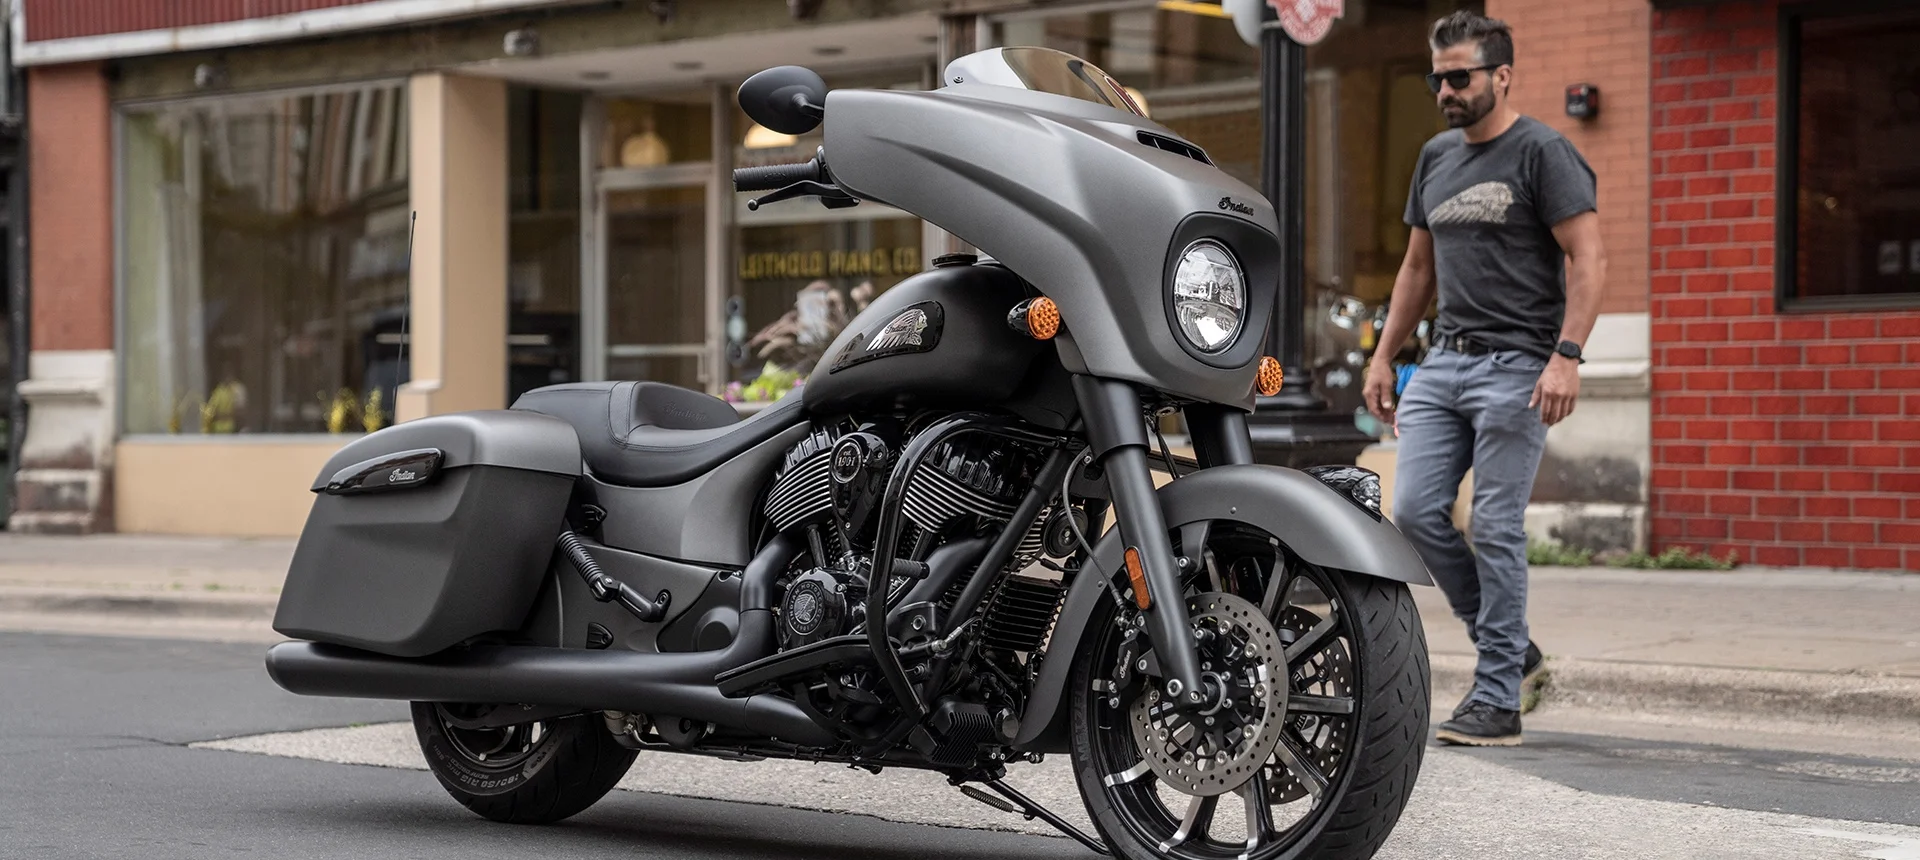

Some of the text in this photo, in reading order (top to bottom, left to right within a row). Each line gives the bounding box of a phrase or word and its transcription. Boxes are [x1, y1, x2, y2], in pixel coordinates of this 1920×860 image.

[1218, 196, 1254, 216] Indian
[828, 249, 887, 275] PIANO
[838, 456, 856, 467] 1901
[389, 468, 415, 482] Indian
